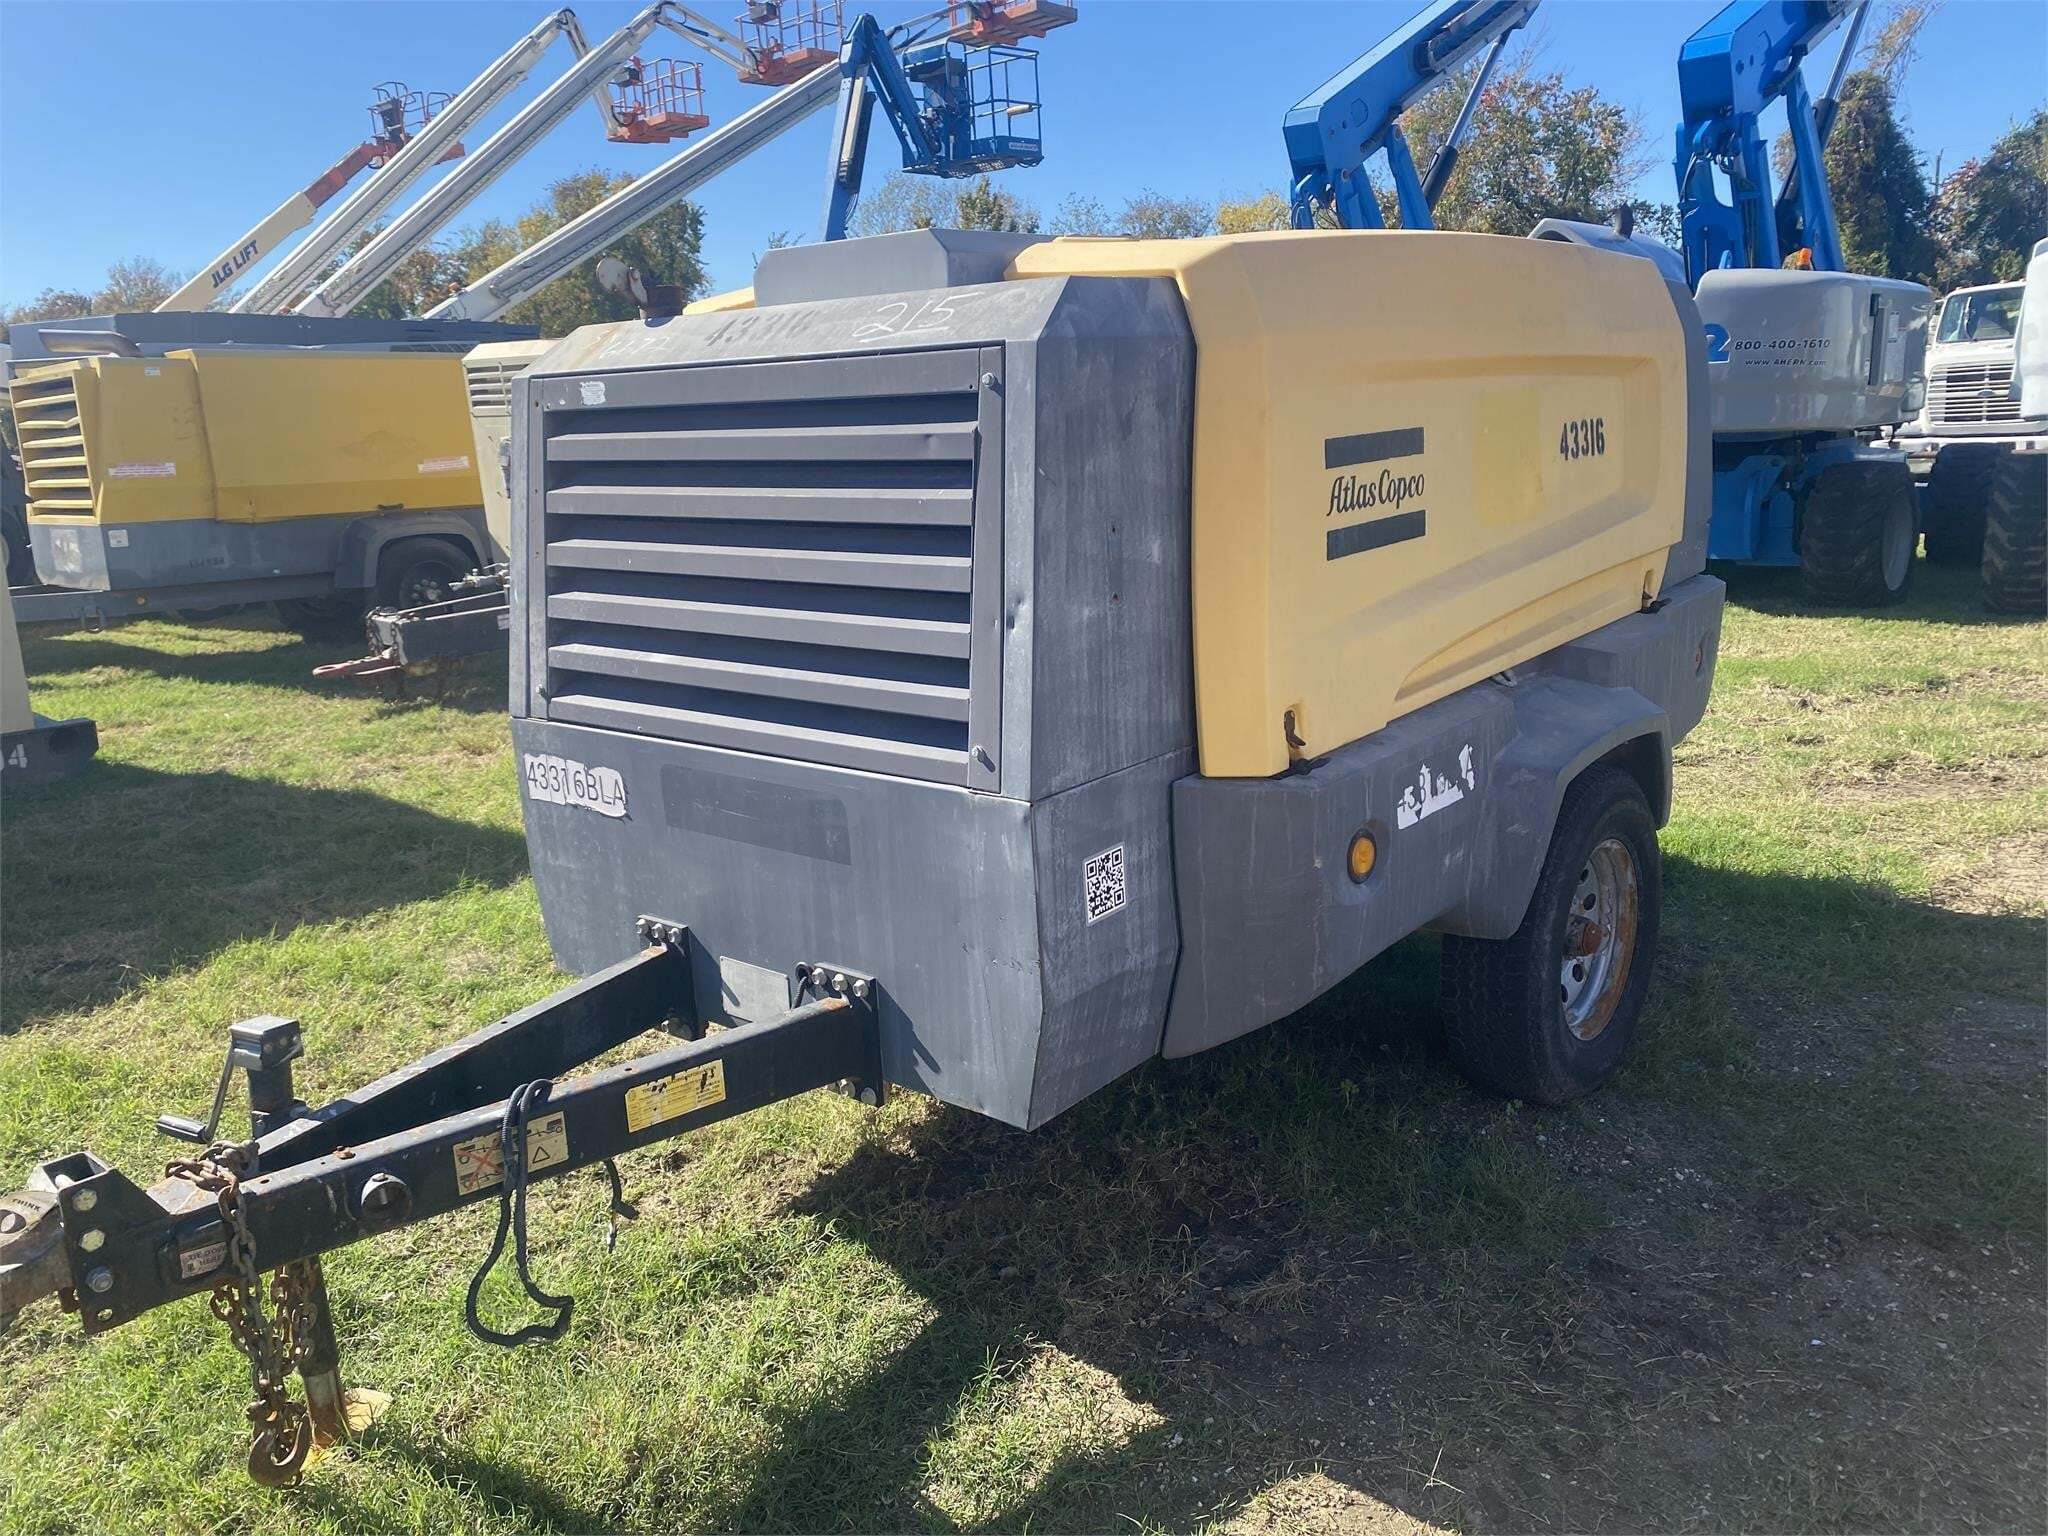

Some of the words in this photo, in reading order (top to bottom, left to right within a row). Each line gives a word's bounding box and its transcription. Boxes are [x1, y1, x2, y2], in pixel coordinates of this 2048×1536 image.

[211, 261, 234, 288] JLG
[233, 239, 258, 270] LIFT
[1734, 338, 1831, 351] 800-400-1610
[1559, 417, 1606, 461] 43316
[1326, 473, 1377, 517] Atlas
[1377, 468, 1425, 509] Copco
